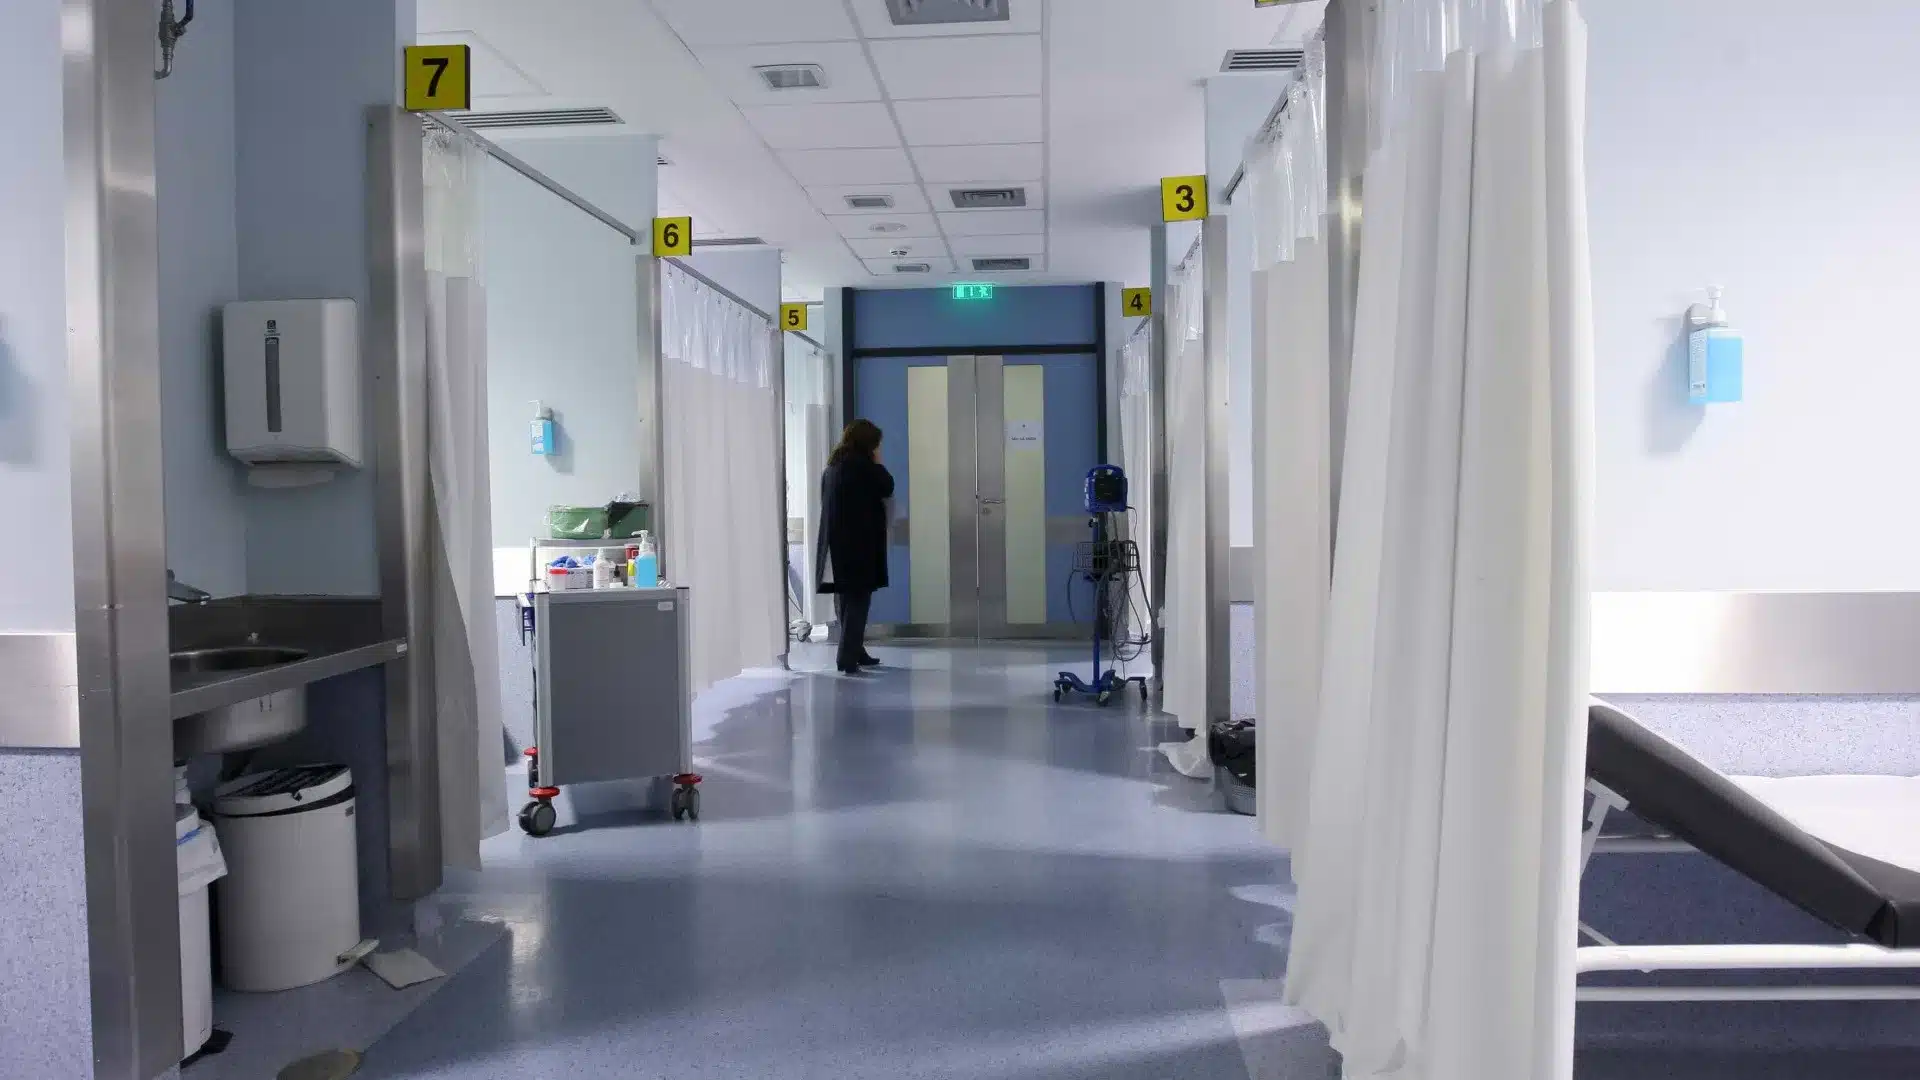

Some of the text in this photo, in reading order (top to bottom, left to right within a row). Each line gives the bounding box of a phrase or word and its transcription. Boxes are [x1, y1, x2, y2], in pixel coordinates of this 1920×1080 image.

[422, 58, 449, 97] 7
[1175, 185, 1195, 212] 3
[663, 223, 679, 248] 6
[1130, 293, 1144, 311] 4
[788, 309, 801, 327] 5
